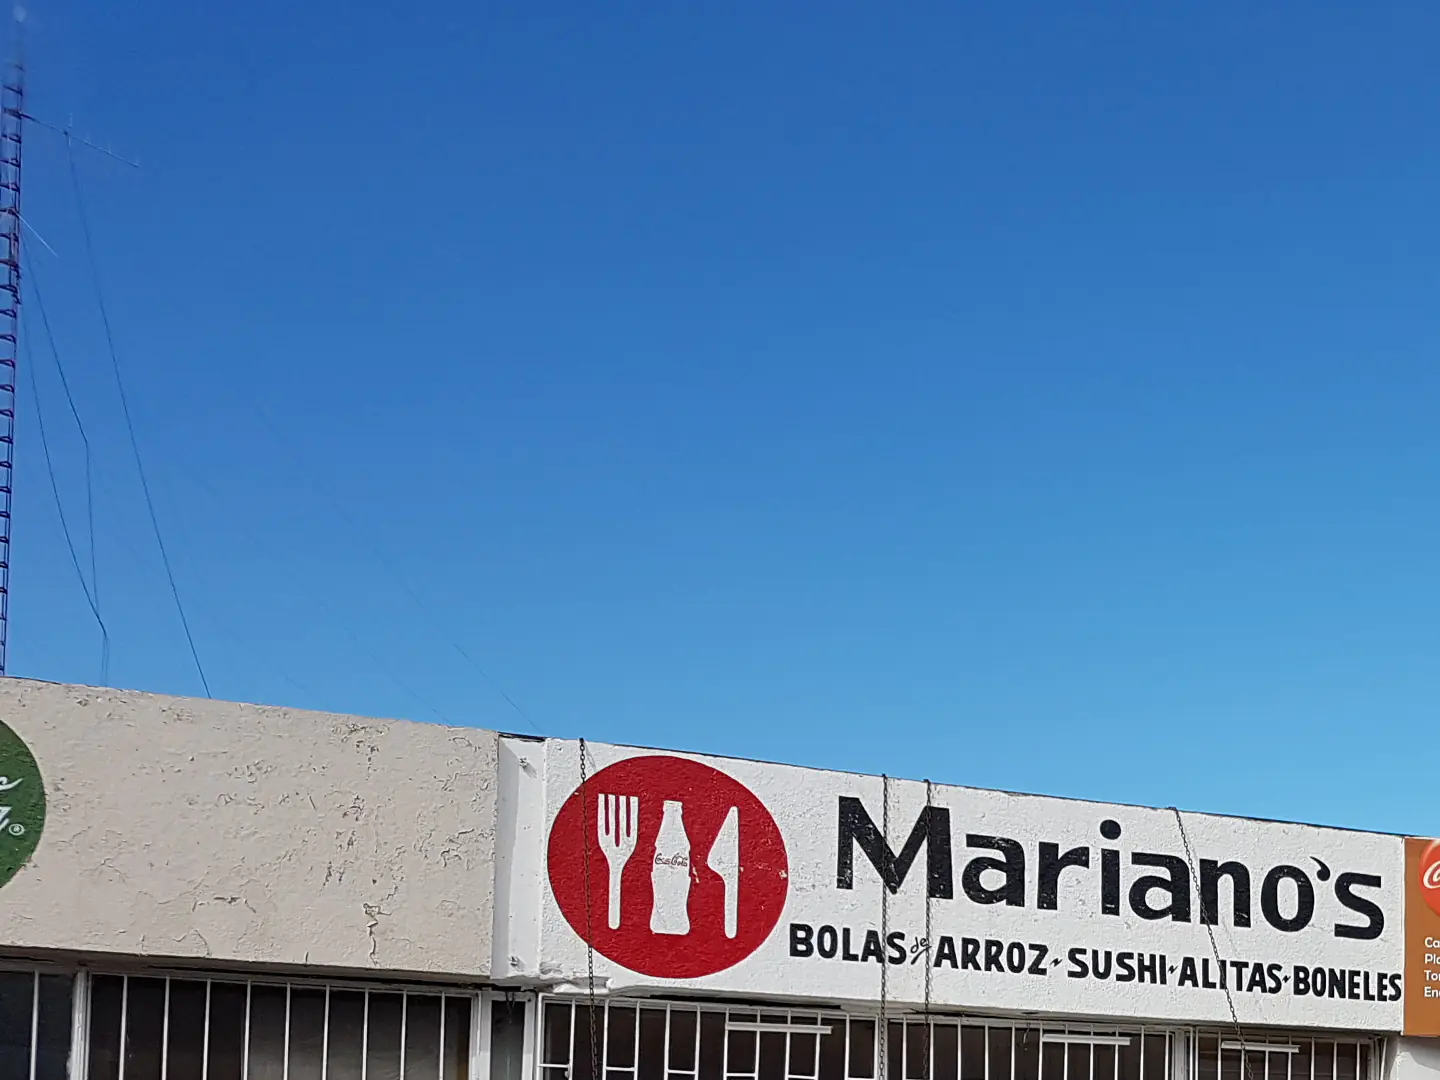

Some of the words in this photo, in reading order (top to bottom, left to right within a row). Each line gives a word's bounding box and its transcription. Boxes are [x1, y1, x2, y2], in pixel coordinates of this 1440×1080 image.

[836, 795, 1385, 941] Mariano's
[789, 923, 907, 966] BOLAS
[910, 936, 930, 956] de
[934, 935, 1049, 977] ARROZ
[1067, 947, 1168, 985] SUSHI
[1178, 956, 1283, 996] ALITAS
[1292, 967, 1402, 1003] BONELES
